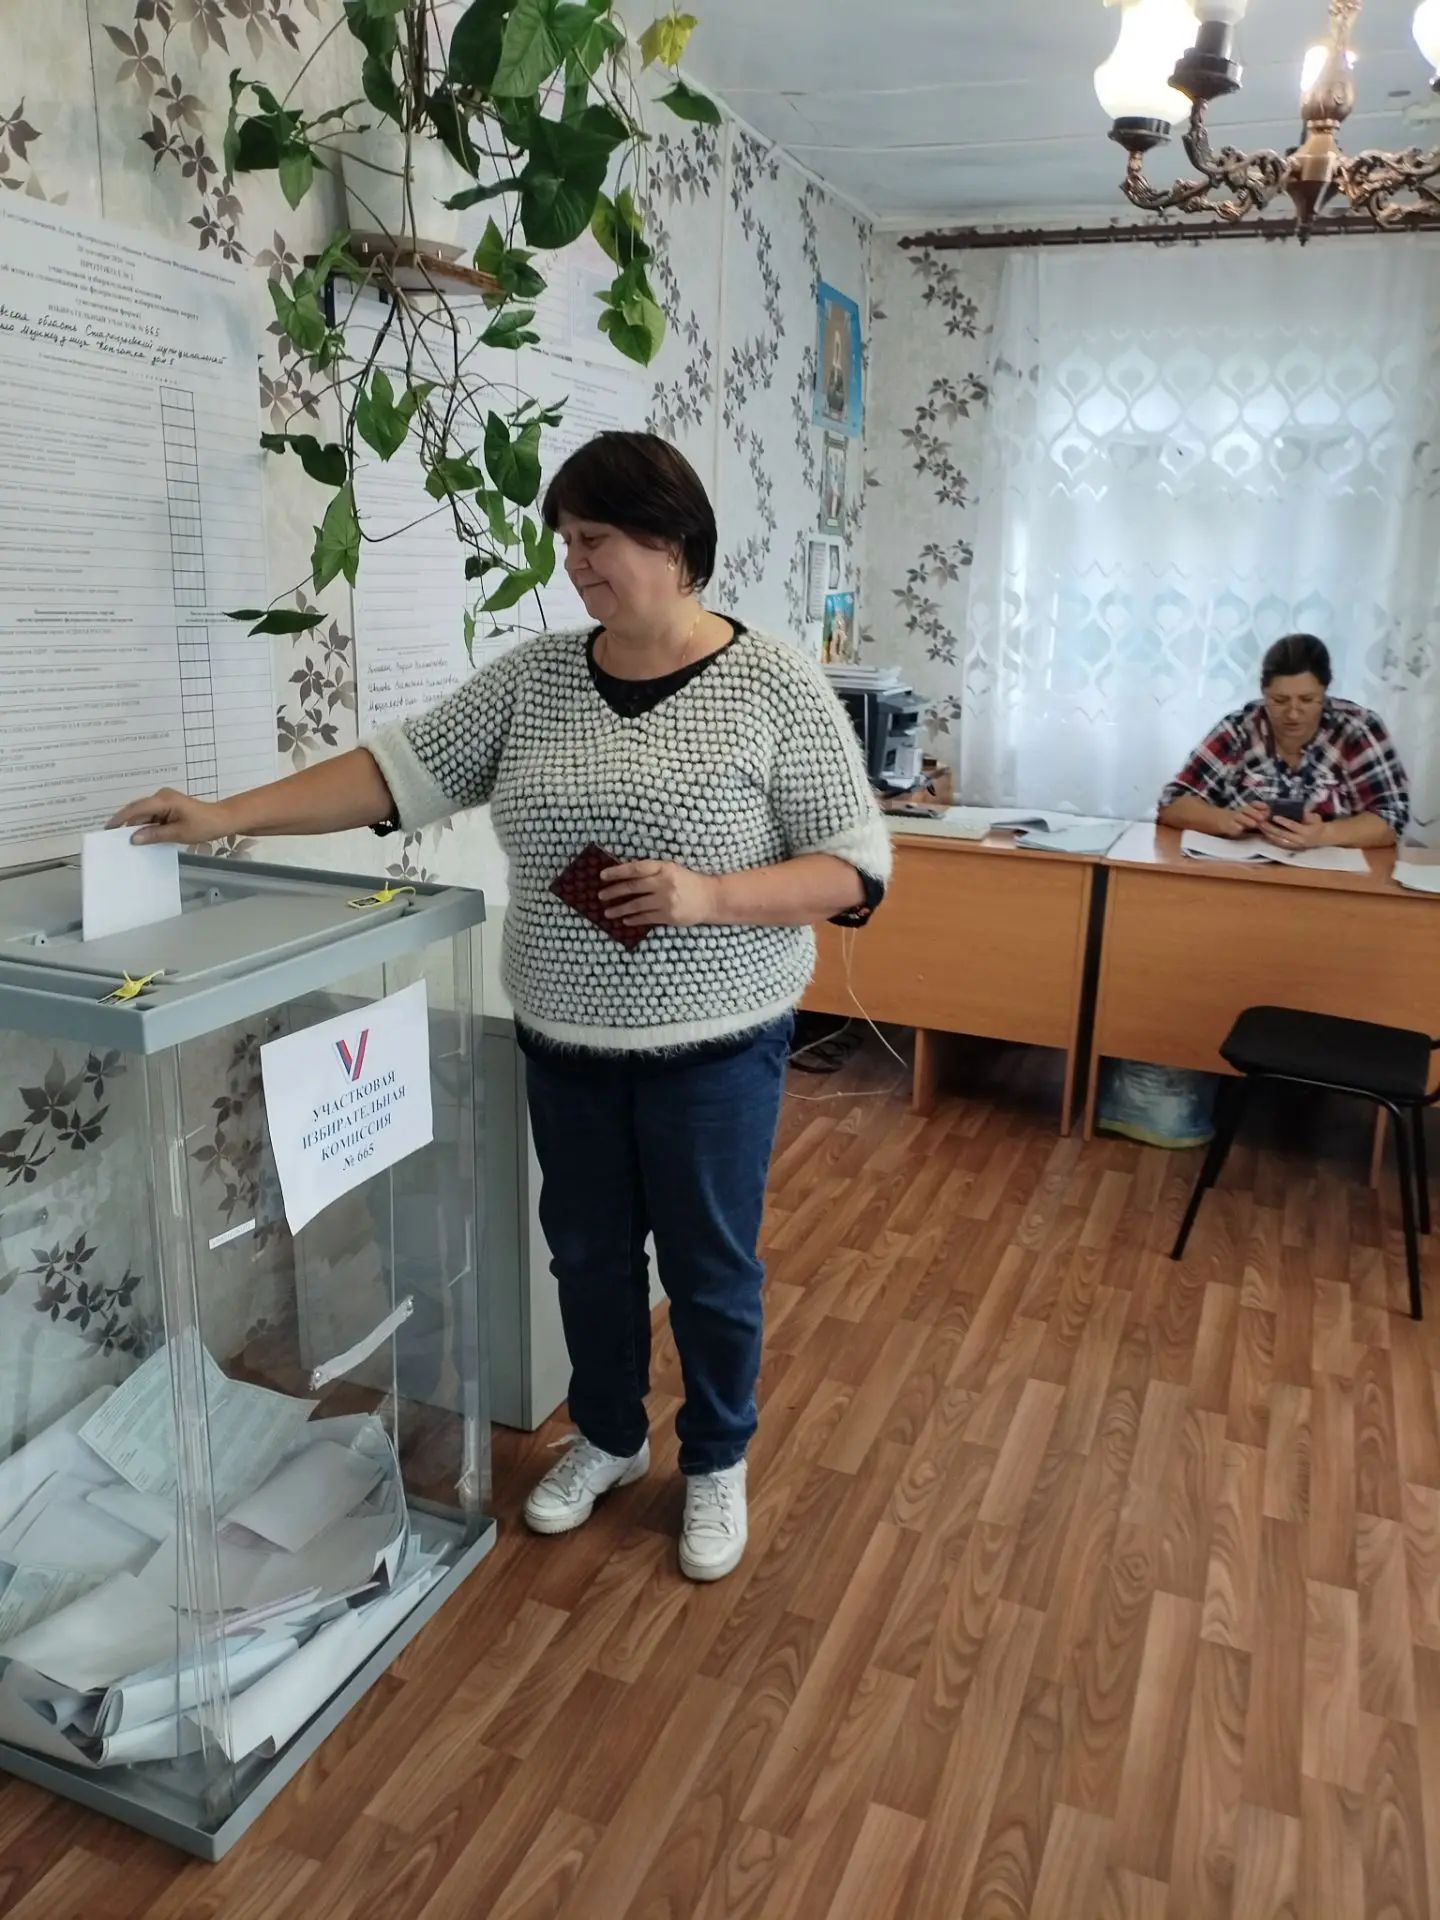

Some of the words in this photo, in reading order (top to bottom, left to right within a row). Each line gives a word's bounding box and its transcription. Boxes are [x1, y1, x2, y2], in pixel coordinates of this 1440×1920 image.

[301, 1085, 406, 1150] ИЗБИРАТЕЛЬНАЯ
[312, 1070, 396, 1122] УЧАСТКОВАЯ
[320, 1112, 392, 1162] КОМИССИЯ
[342, 1154, 356, 1171] №
[356, 1143, 376, 1163] 665
